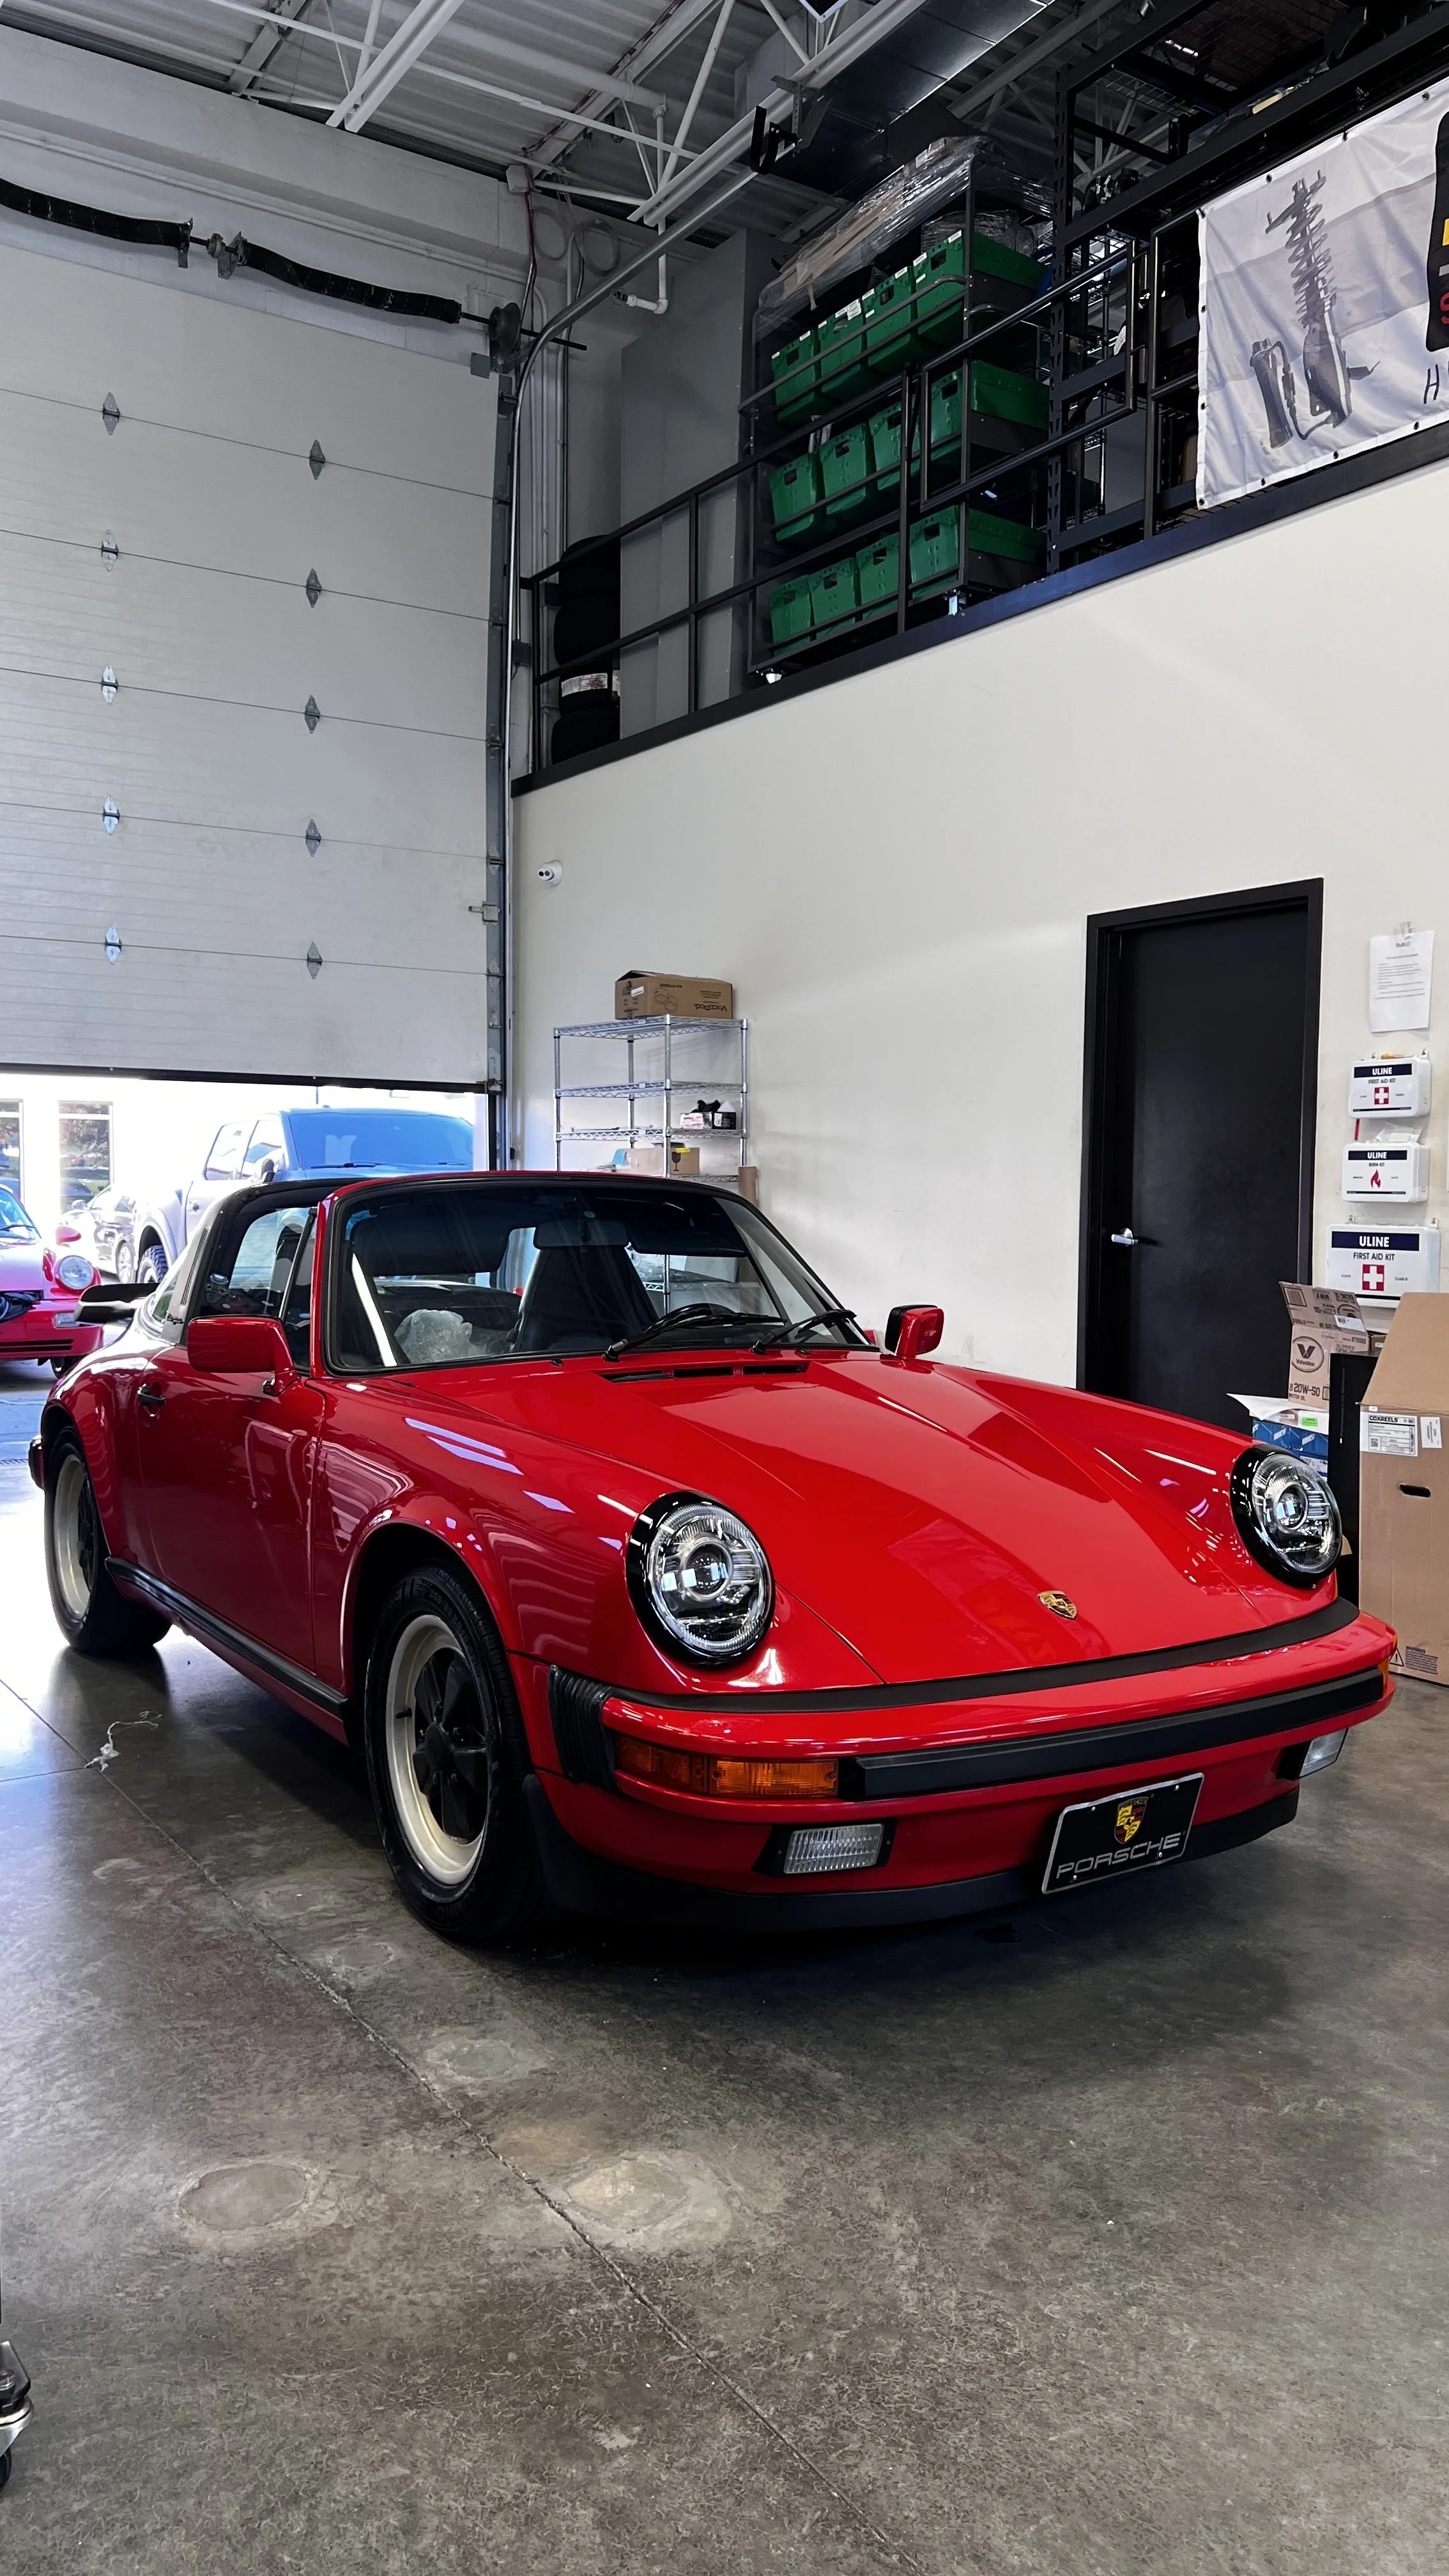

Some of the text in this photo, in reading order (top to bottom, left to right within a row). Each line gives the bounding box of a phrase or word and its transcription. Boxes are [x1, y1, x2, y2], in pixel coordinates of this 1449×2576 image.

[1372, 1067, 1393, 1075] ULINE
[1359, 1236, 1390, 1248] ULINE
[1353, 1252, 1370, 1260] FIRST
[1294, 1383, 1320, 1397] 20W-50
[1055, 1832, 1181, 1880] PORSCHE
